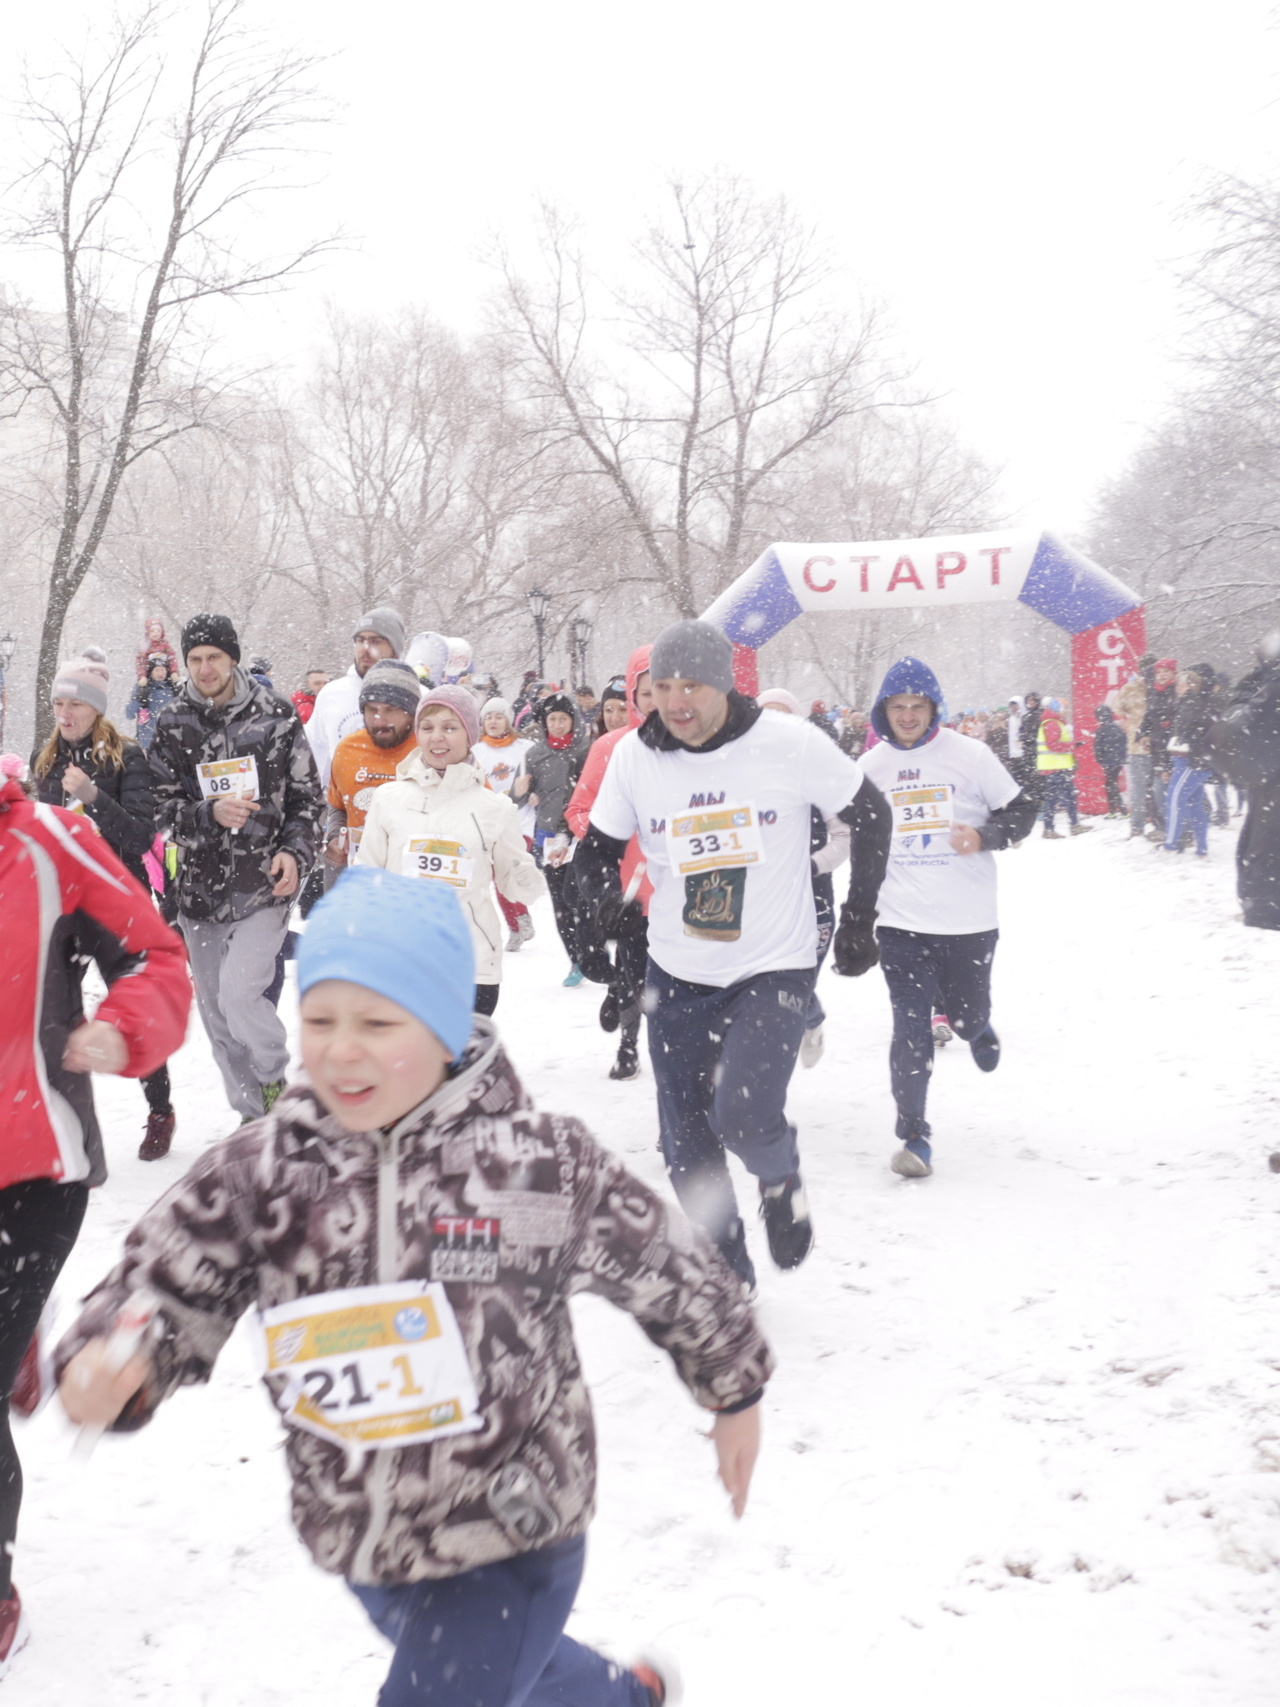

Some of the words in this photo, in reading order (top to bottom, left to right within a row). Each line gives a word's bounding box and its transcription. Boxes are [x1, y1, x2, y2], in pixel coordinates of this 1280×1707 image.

[803, 547, 1012, 593] СТАРТ
[689, 791, 726, 808] МЫ
[903, 805, 940, 821] 34-1
[689, 832, 743, 856] 33-1
[418, 855, 459, 874] 39-1
[302, 1354, 424, 1410] 21-1
